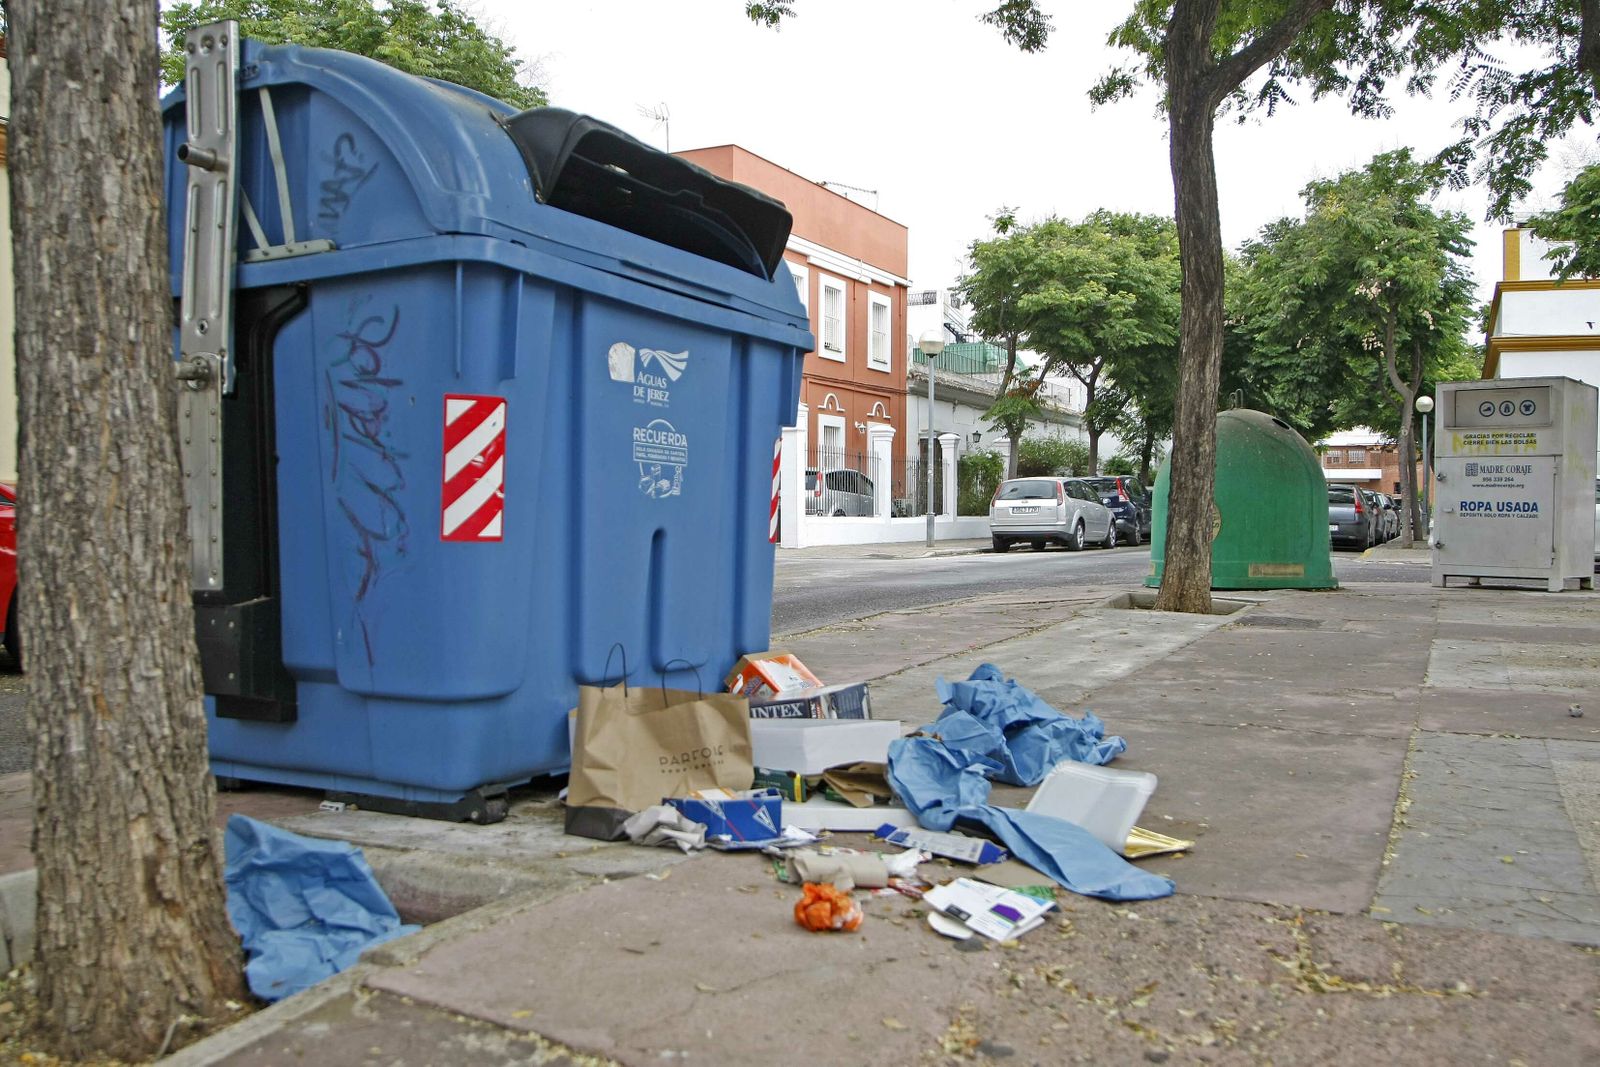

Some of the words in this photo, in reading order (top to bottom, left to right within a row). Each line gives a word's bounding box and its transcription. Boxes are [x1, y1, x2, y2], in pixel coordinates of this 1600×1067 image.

[636, 371, 667, 389] AGUAS
[633, 385, 645, 397] DE
[647, 387, 670, 403] JEREZ
[633, 427, 688, 447] RECUERDA
[1480, 465, 1504, 474] MADRE
[1506, 464, 1532, 476] CORAJE
[1460, 501, 1492, 512] ROPA
[1496, 501, 1539, 512] USADA
[751, 702, 803, 718] INTEX
